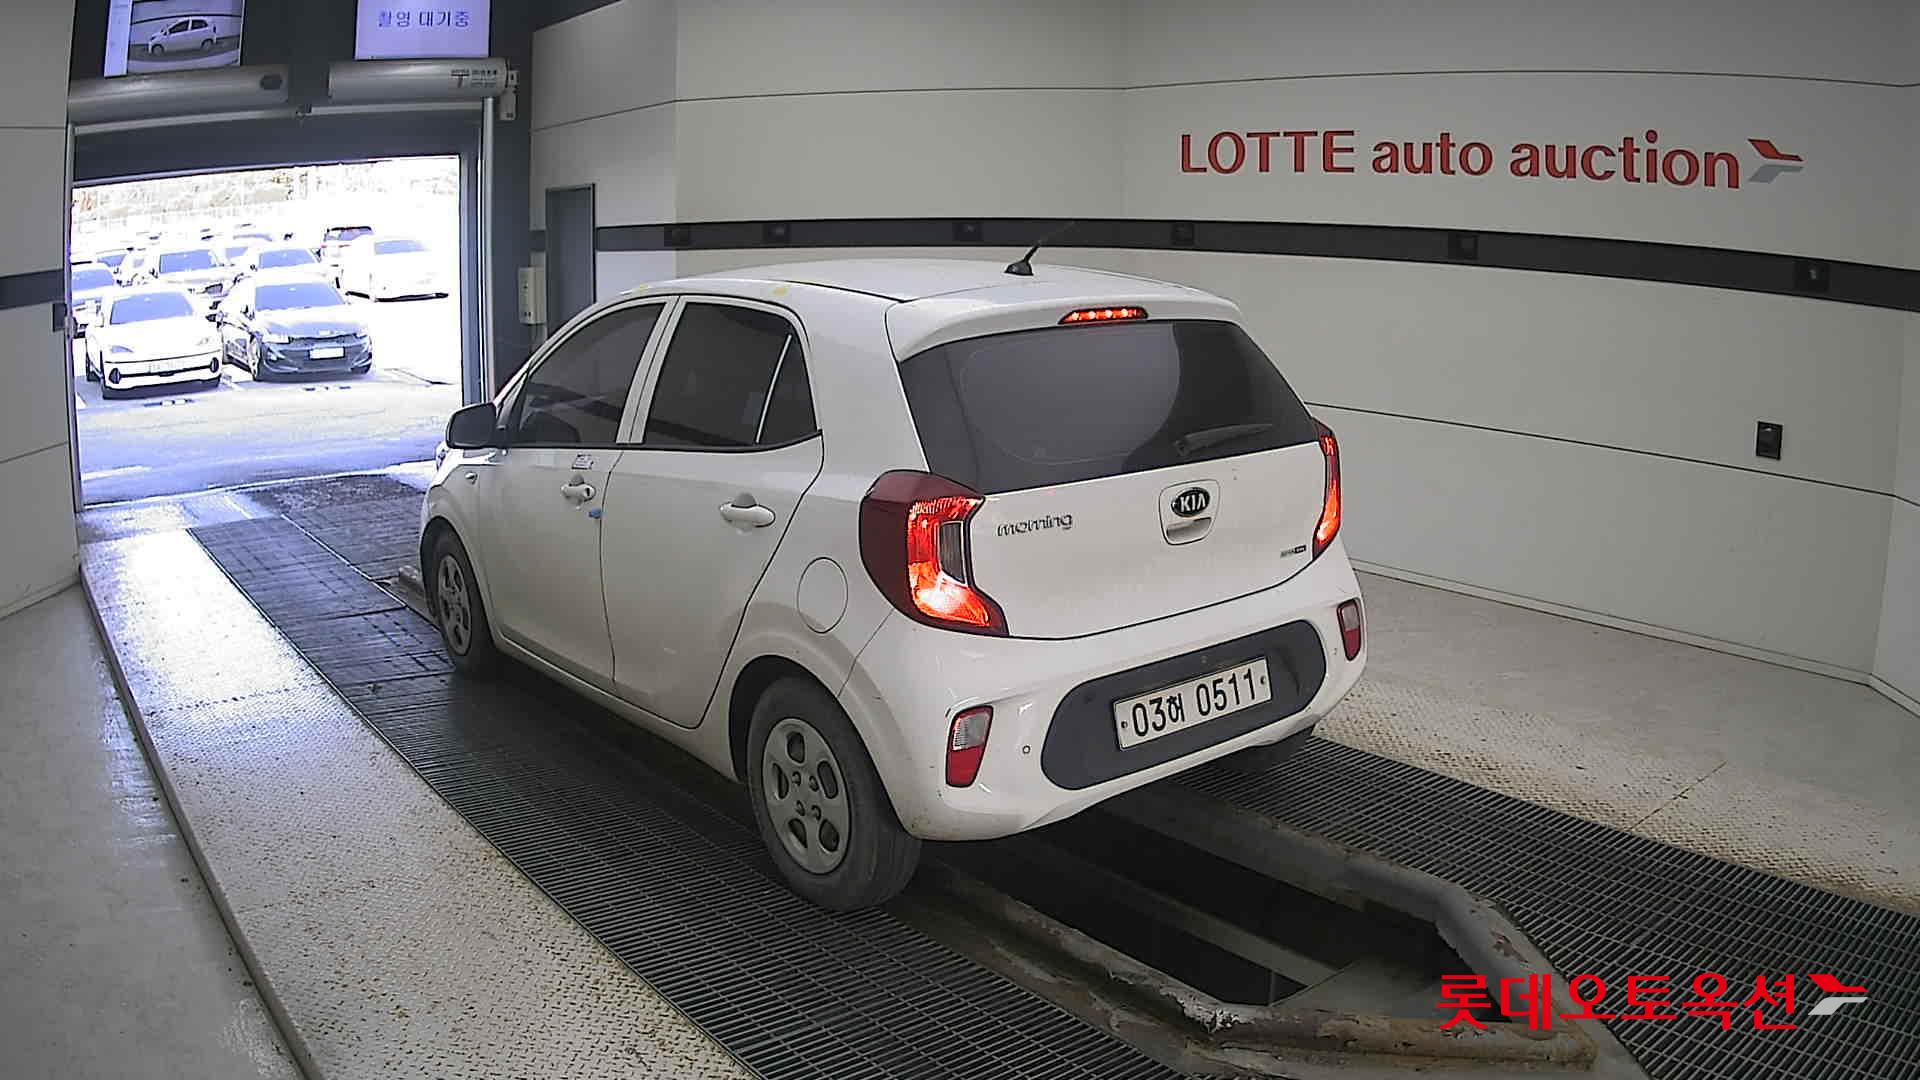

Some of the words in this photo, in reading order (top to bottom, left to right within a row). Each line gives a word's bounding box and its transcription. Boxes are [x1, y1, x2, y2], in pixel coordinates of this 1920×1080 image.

[419, 10, 469, 28] 대기중
[1180, 130, 1356, 174] LOTTE
[1371, 132, 1493, 176] auto
[1510, 129, 1740, 190] auction
[1178, 494, 1207, 512] KIA
[997, 513, 1073, 537] morning
[1132, 693, 1185, 737] 03허
[1196, 668, 1256, 716] 0511
